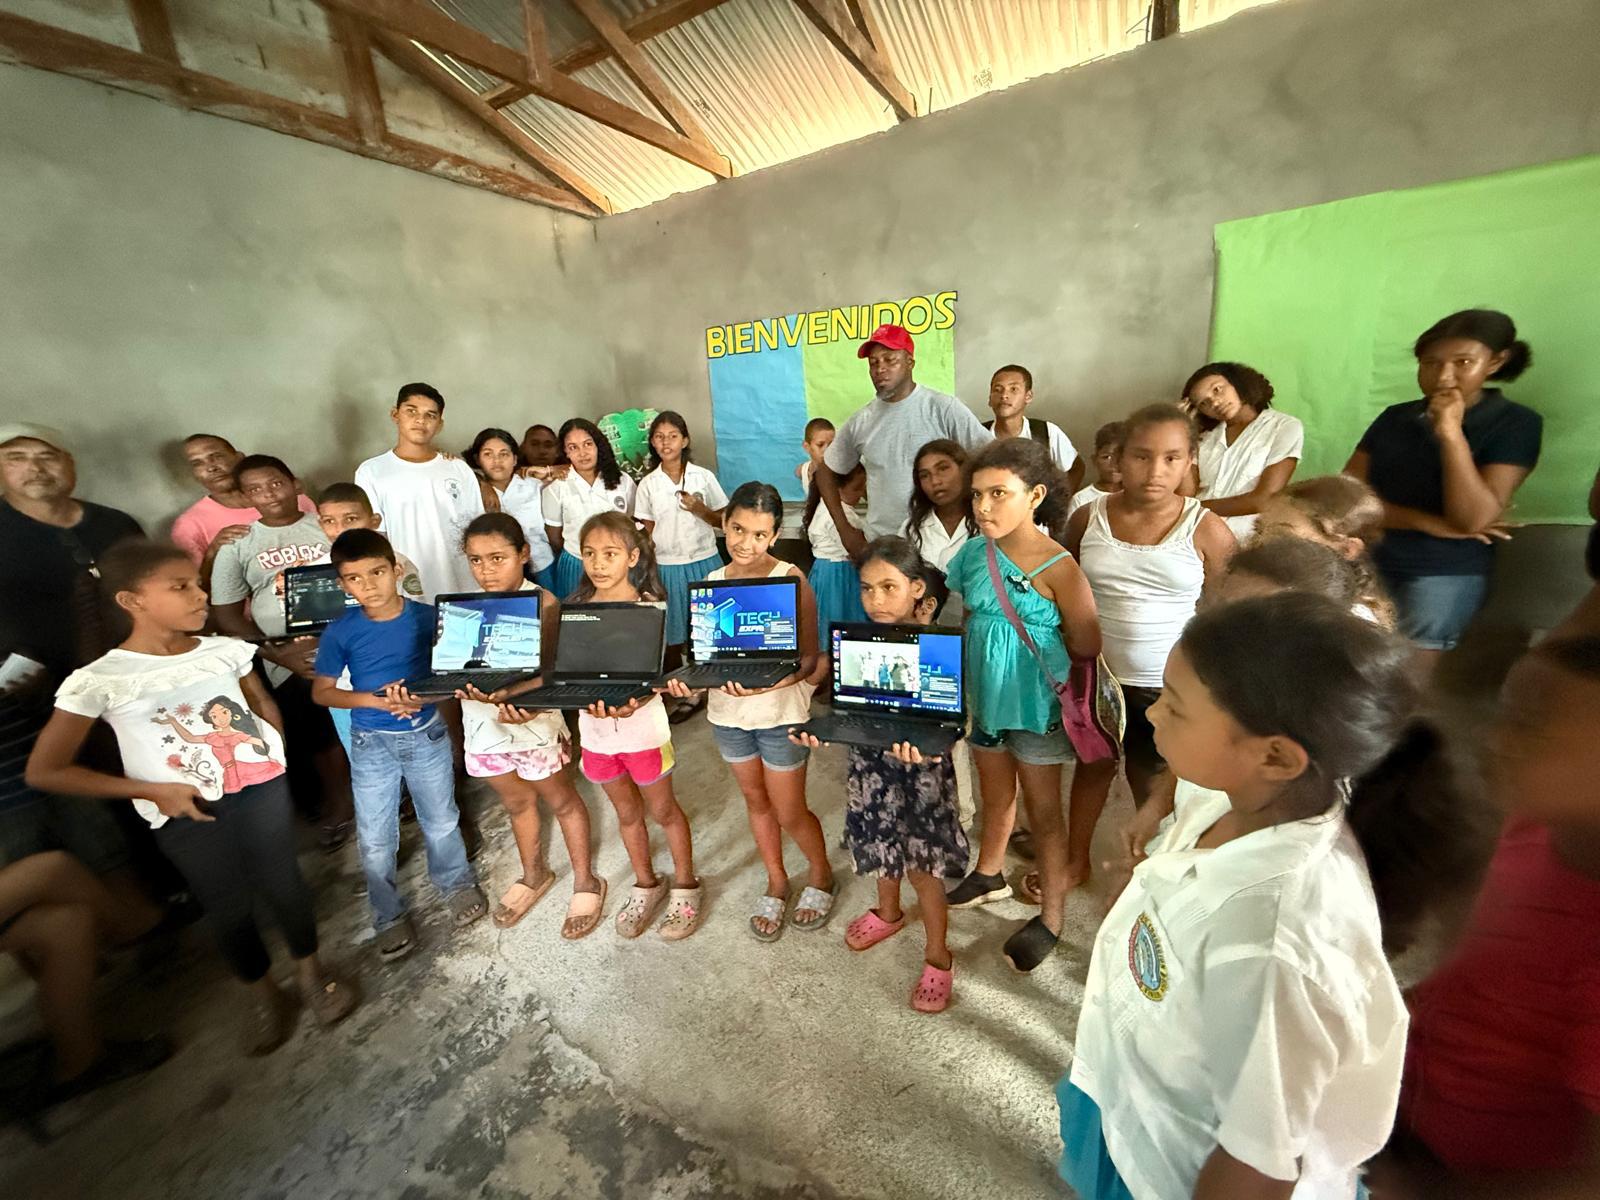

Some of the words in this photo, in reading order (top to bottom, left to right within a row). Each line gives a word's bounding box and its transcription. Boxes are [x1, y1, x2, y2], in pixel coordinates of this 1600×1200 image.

[706, 290, 958, 359] BIENVENIDOS
[256, 543, 325, 570] ROBLOX
[737, 611, 781, 625] TECH
